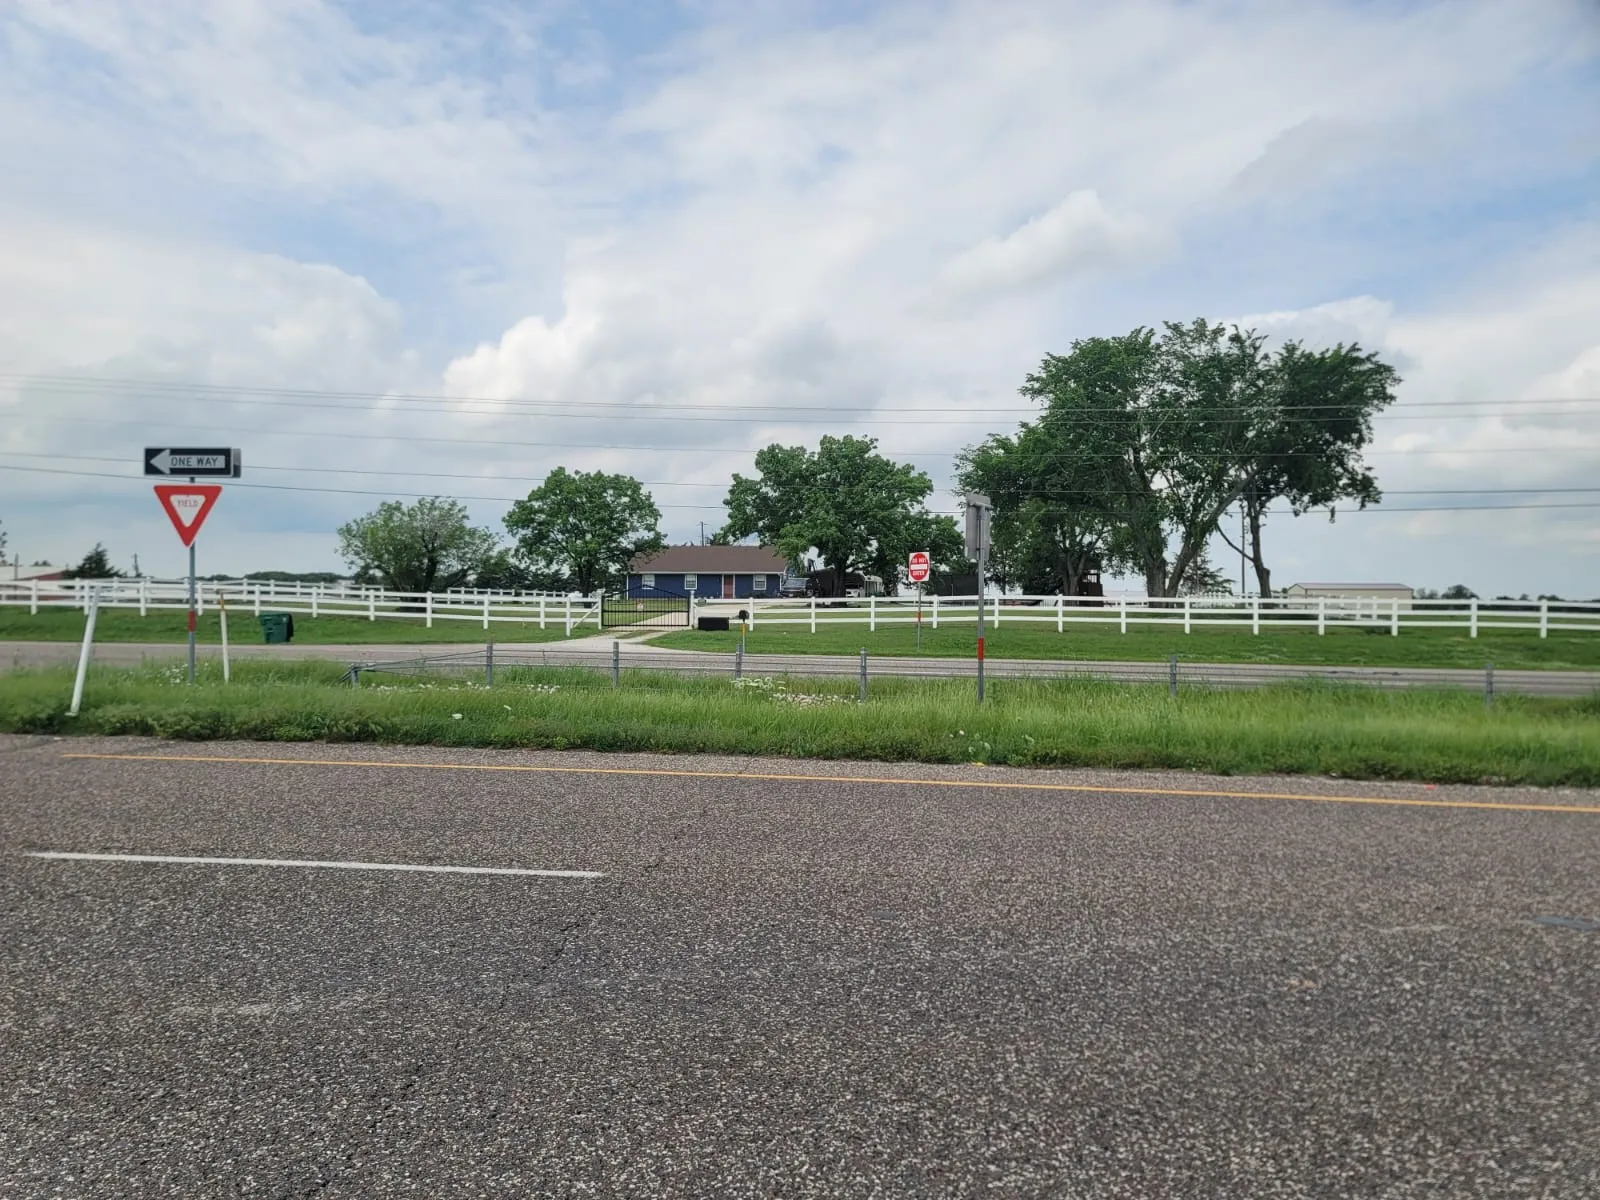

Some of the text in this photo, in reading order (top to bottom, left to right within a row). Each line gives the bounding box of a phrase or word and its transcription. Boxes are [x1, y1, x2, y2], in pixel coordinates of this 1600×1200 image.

[171, 457, 218, 466] ONE WAY
[177, 499, 199, 507] YIELD
